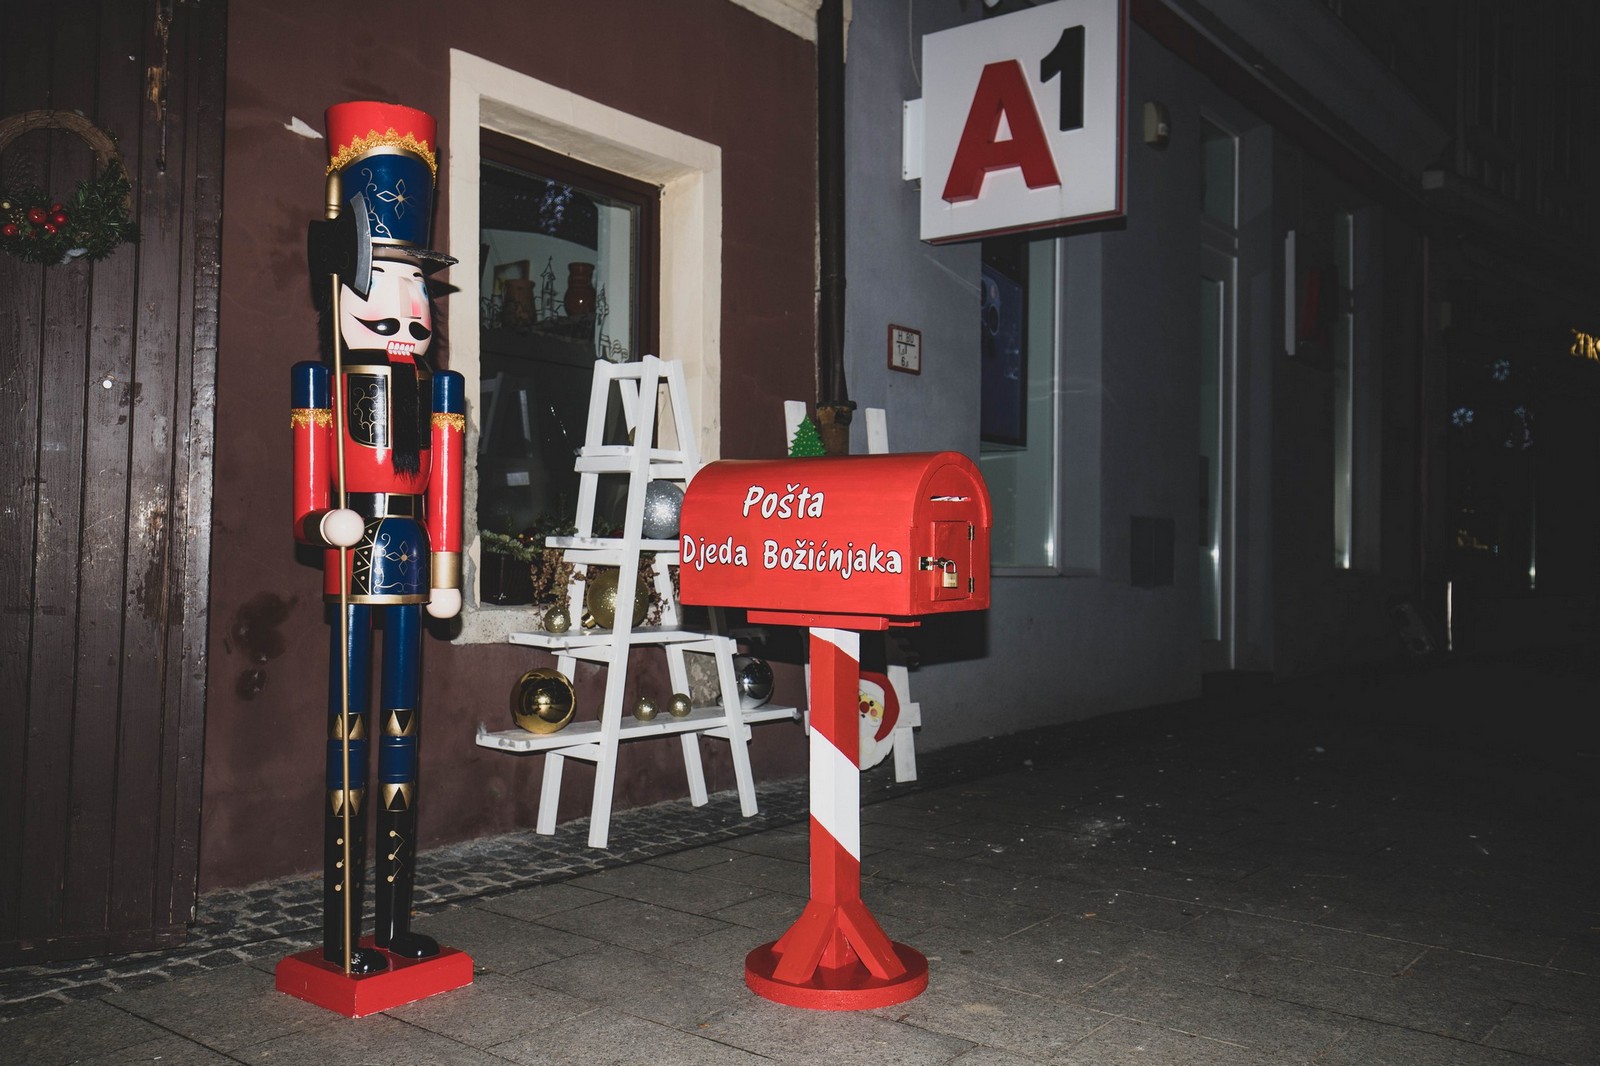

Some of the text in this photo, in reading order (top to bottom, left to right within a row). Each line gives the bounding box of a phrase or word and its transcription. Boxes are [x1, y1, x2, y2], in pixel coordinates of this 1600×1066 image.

[941, 24, 1086, 204] A1
[742, 483, 825, 519] Pošta
[682, 534, 903, 579] Djeda Božićnjaka
